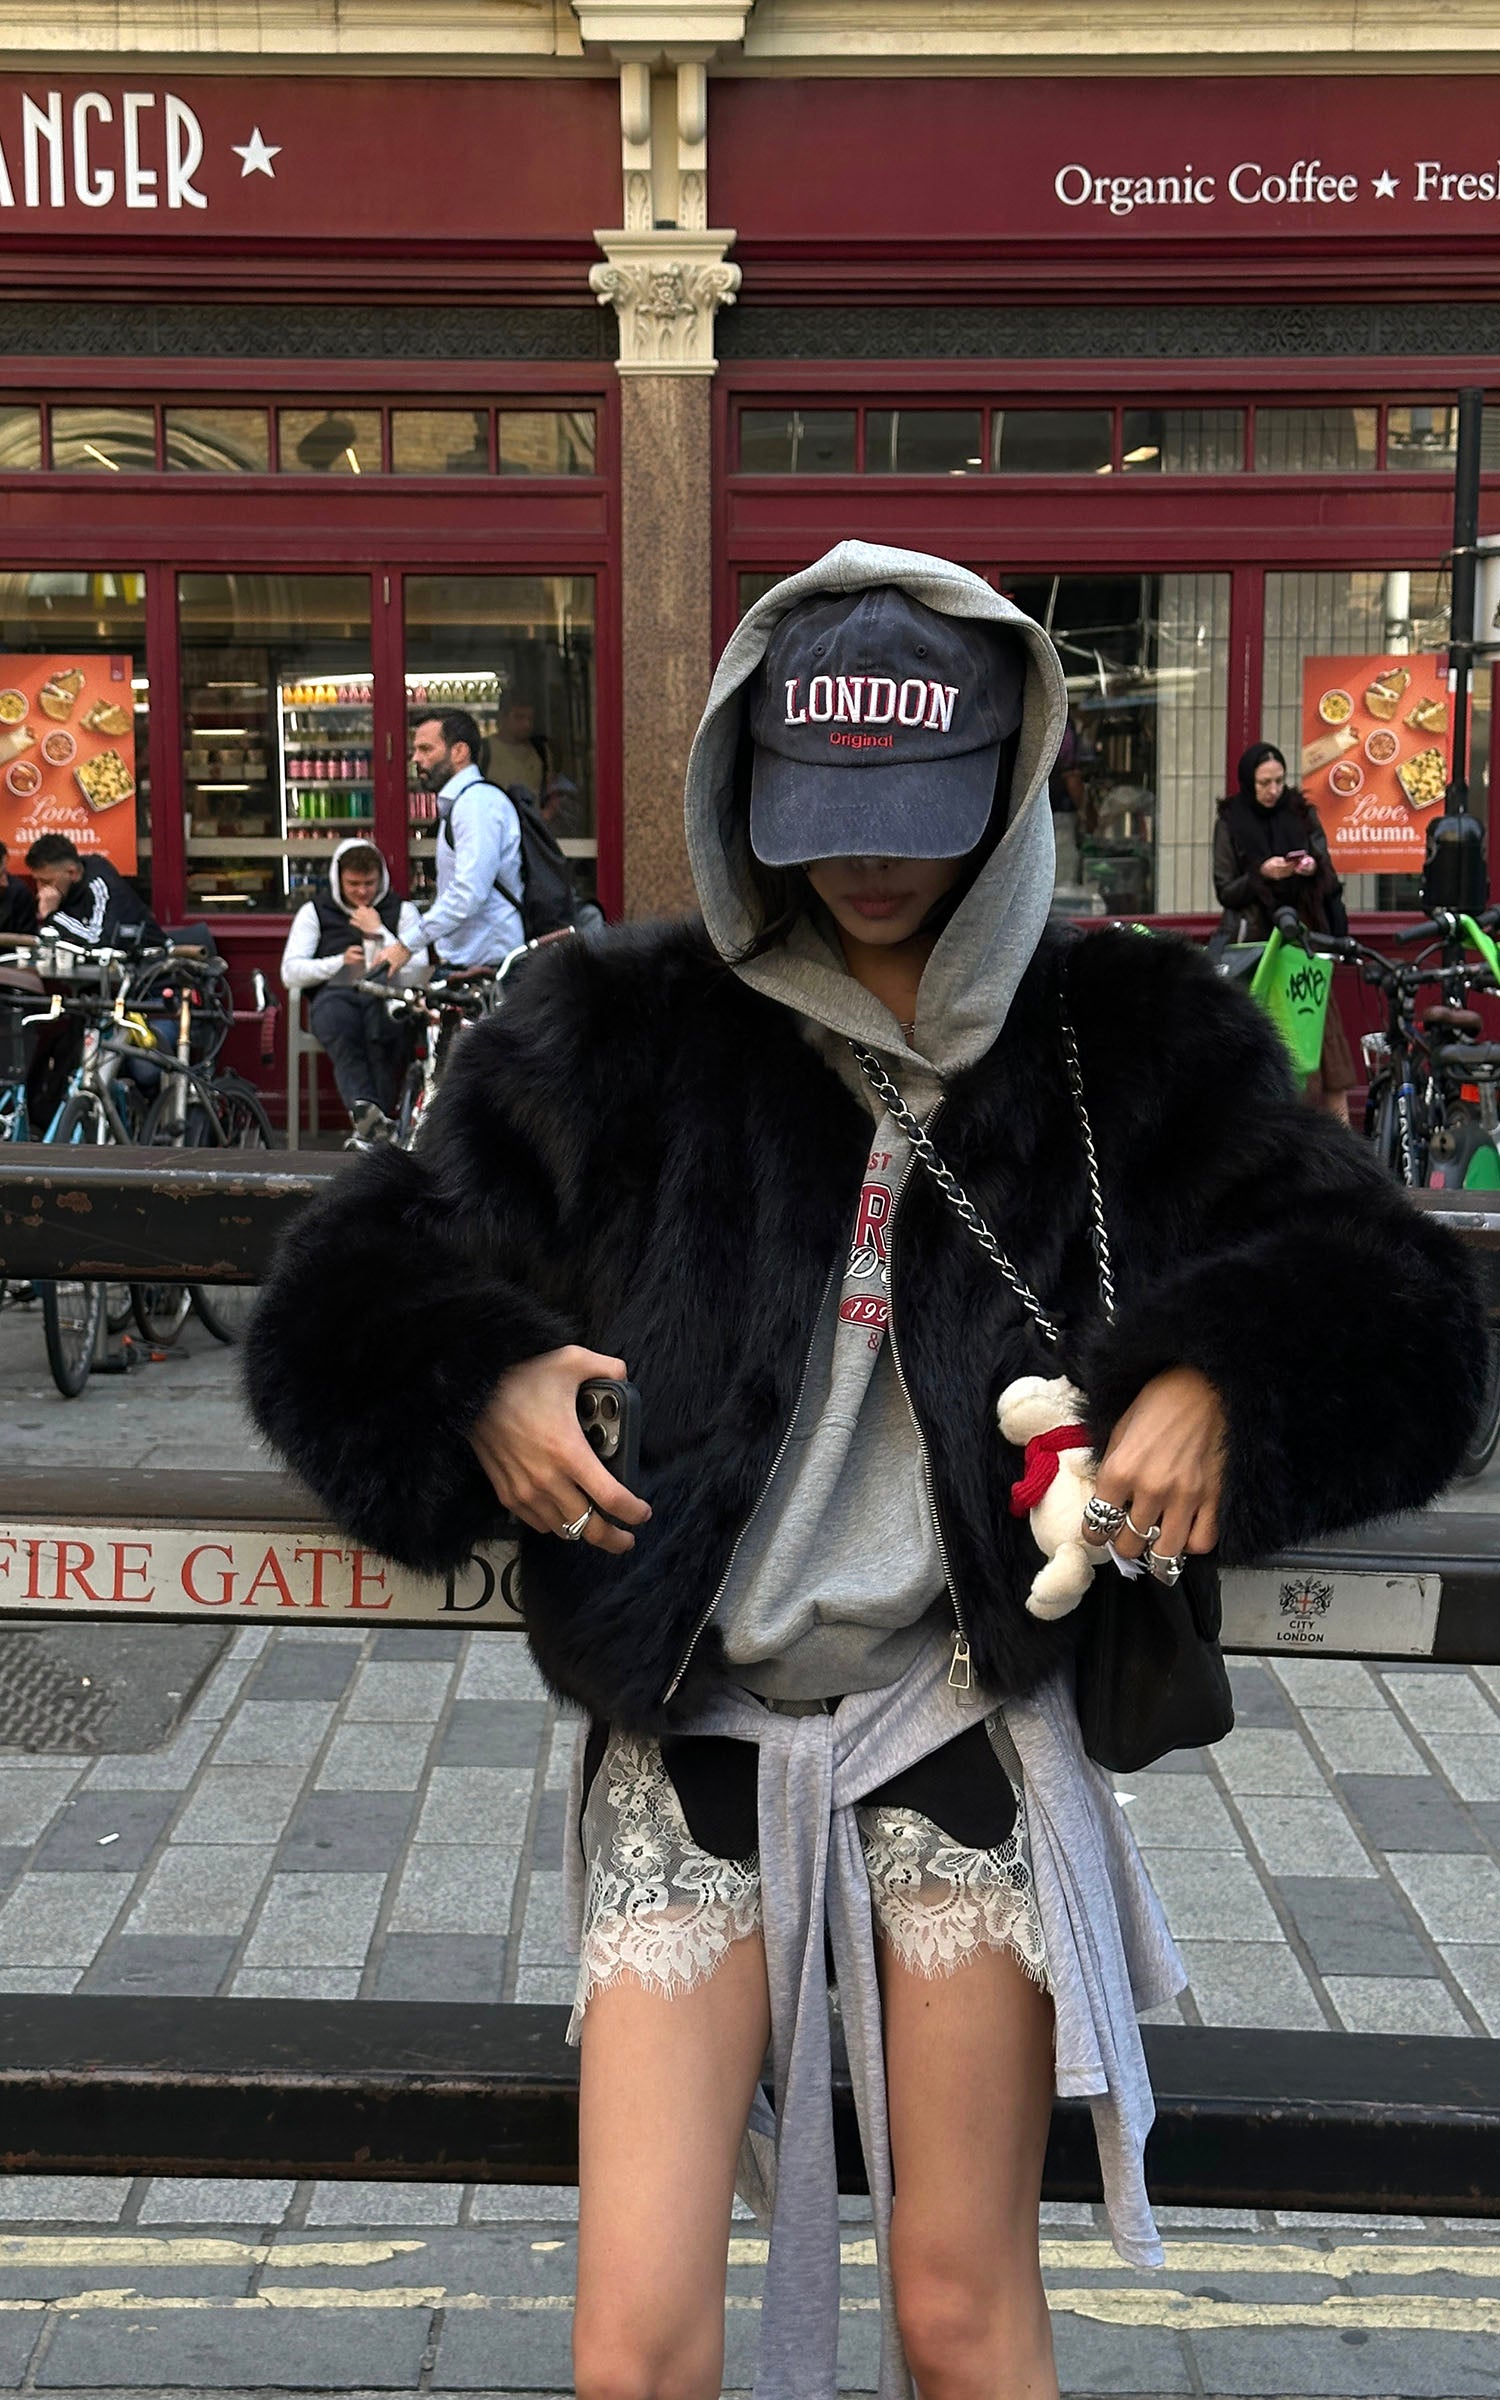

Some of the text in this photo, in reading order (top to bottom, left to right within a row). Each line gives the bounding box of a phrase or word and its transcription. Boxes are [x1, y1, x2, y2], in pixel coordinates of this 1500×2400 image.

[1054, 159, 1500, 216] Organic Coffee Fres
[784, 675, 960, 733] LONDON
[830, 731, 894, 749] Original
[1343, 793, 1409, 826] Love,
[180, 1544, 394, 1610] GATE
[1277, 1631, 1325, 1642] LONDON
[1289, 1620, 1316, 1629] CITY
